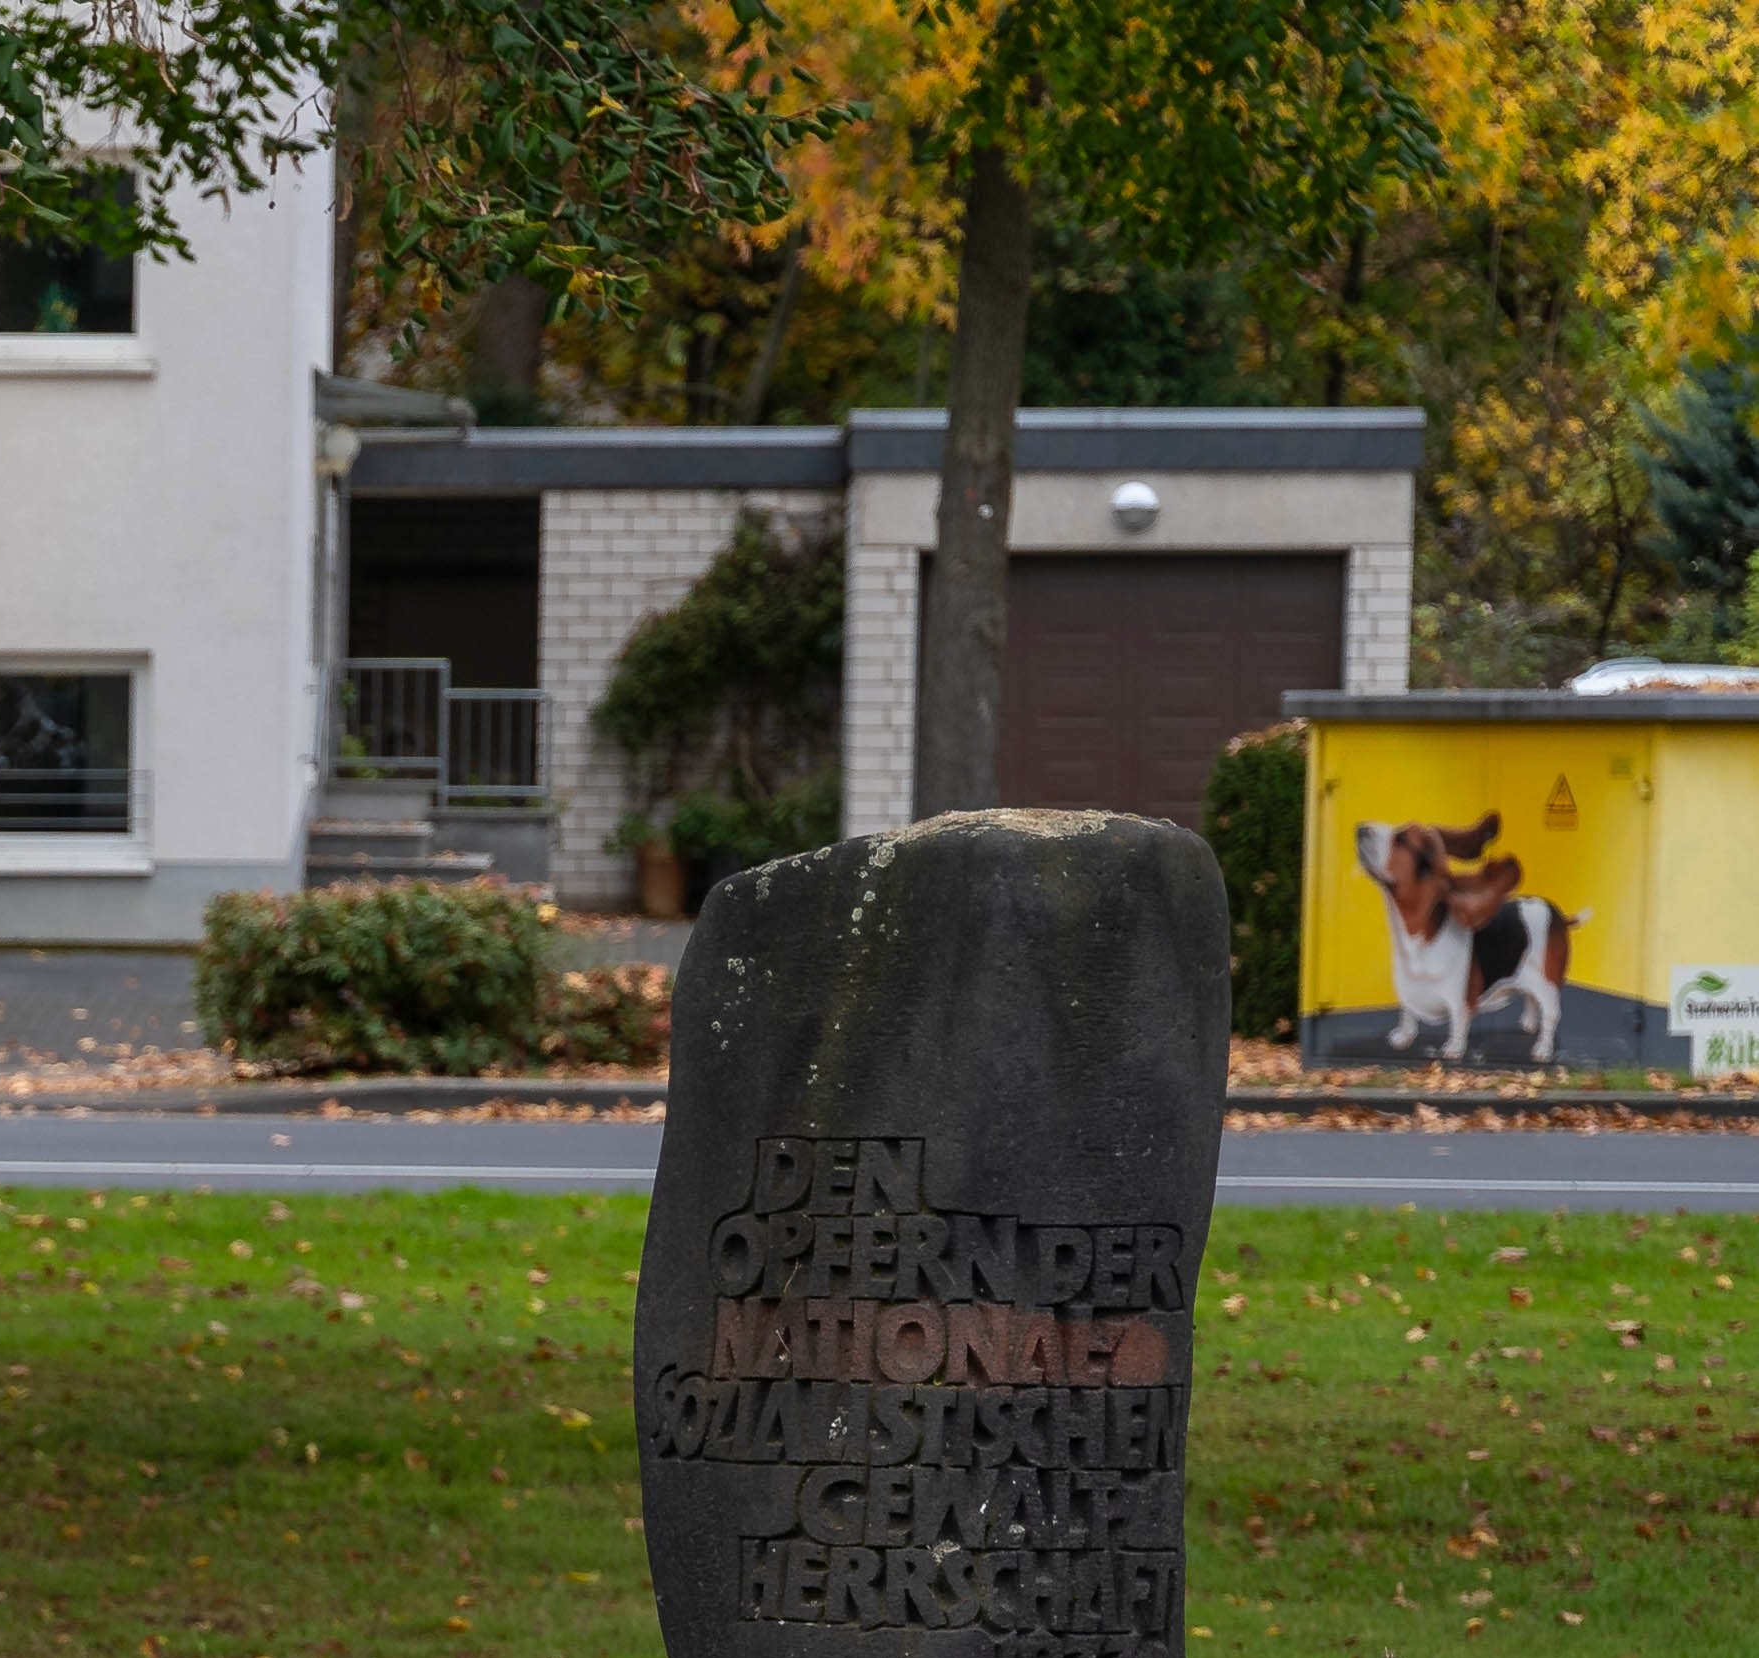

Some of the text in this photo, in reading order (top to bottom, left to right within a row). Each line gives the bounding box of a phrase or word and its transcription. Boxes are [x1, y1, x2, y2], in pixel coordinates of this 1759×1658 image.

[755, 1137, 924, 1215] DEN
[709, 1212, 1183, 1310] OPFERN DER
[651, 1364, 1183, 1470] SOZIALISTISCHEN
[739, 1536, 1177, 1636] HERRSCHAFT
